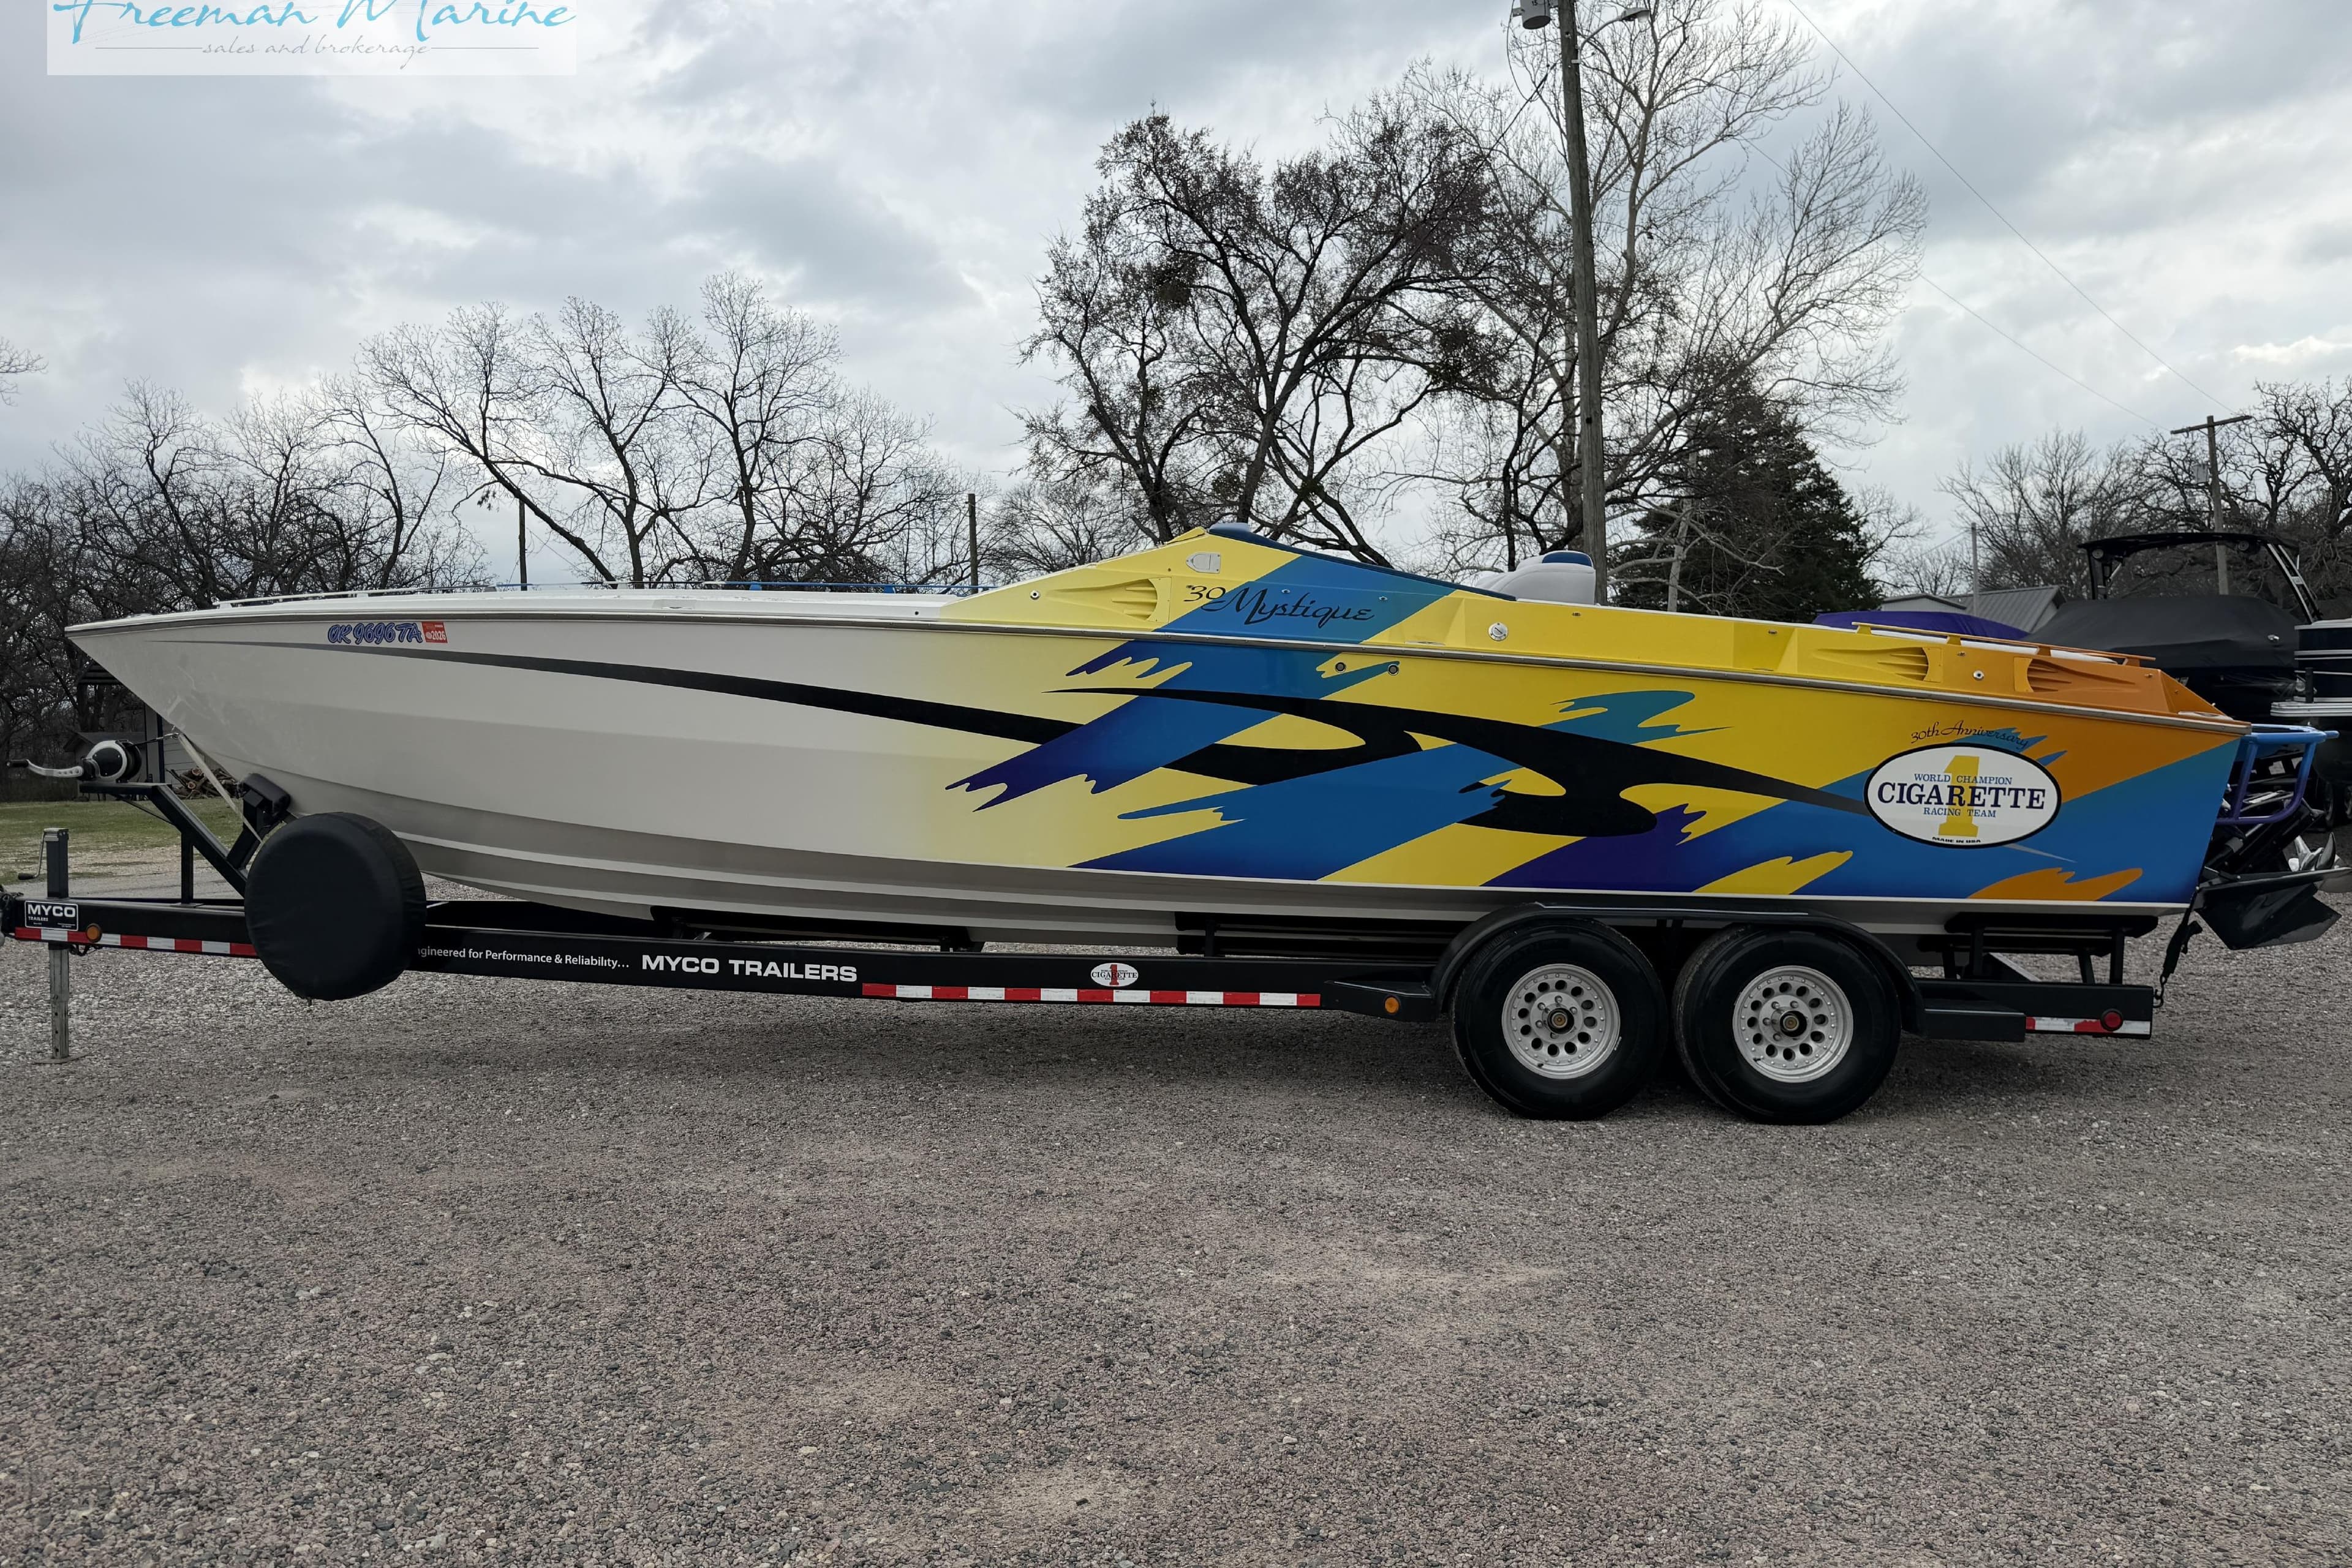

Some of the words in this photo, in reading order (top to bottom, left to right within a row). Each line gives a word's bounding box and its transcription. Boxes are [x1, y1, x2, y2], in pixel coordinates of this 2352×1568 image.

[1183, 585, 1226, 602] 30
[1200, 586, 1376, 629] Mystique
[328, 624, 353, 644] OK
[353, 622, 396, 644] 9696
[396, 622, 423, 643] TA
[431, 630, 446, 641] 2026
[1911, 721, 1940, 744] 30th
[1940, 720, 2029, 750] Anniversary
[1914, 773, 1951, 783] WORLD
[1956, 775, 2013, 785] CHAMPION
[1877, 782, 2046, 810] CIGARETTE
[1939, 755, 1980, 837] 1
[1923, 807, 1961, 816] RACING
[1967, 809, 1997, 818] TEAM
[28, 904, 76, 918] MYCO
[468, 948, 484, 959] for
[485, 950, 552, 963] Performance
[554, 954, 563, 964] &
[642, 954, 720, 974] MYCO
[728, 959, 858, 982] TRAILERS
